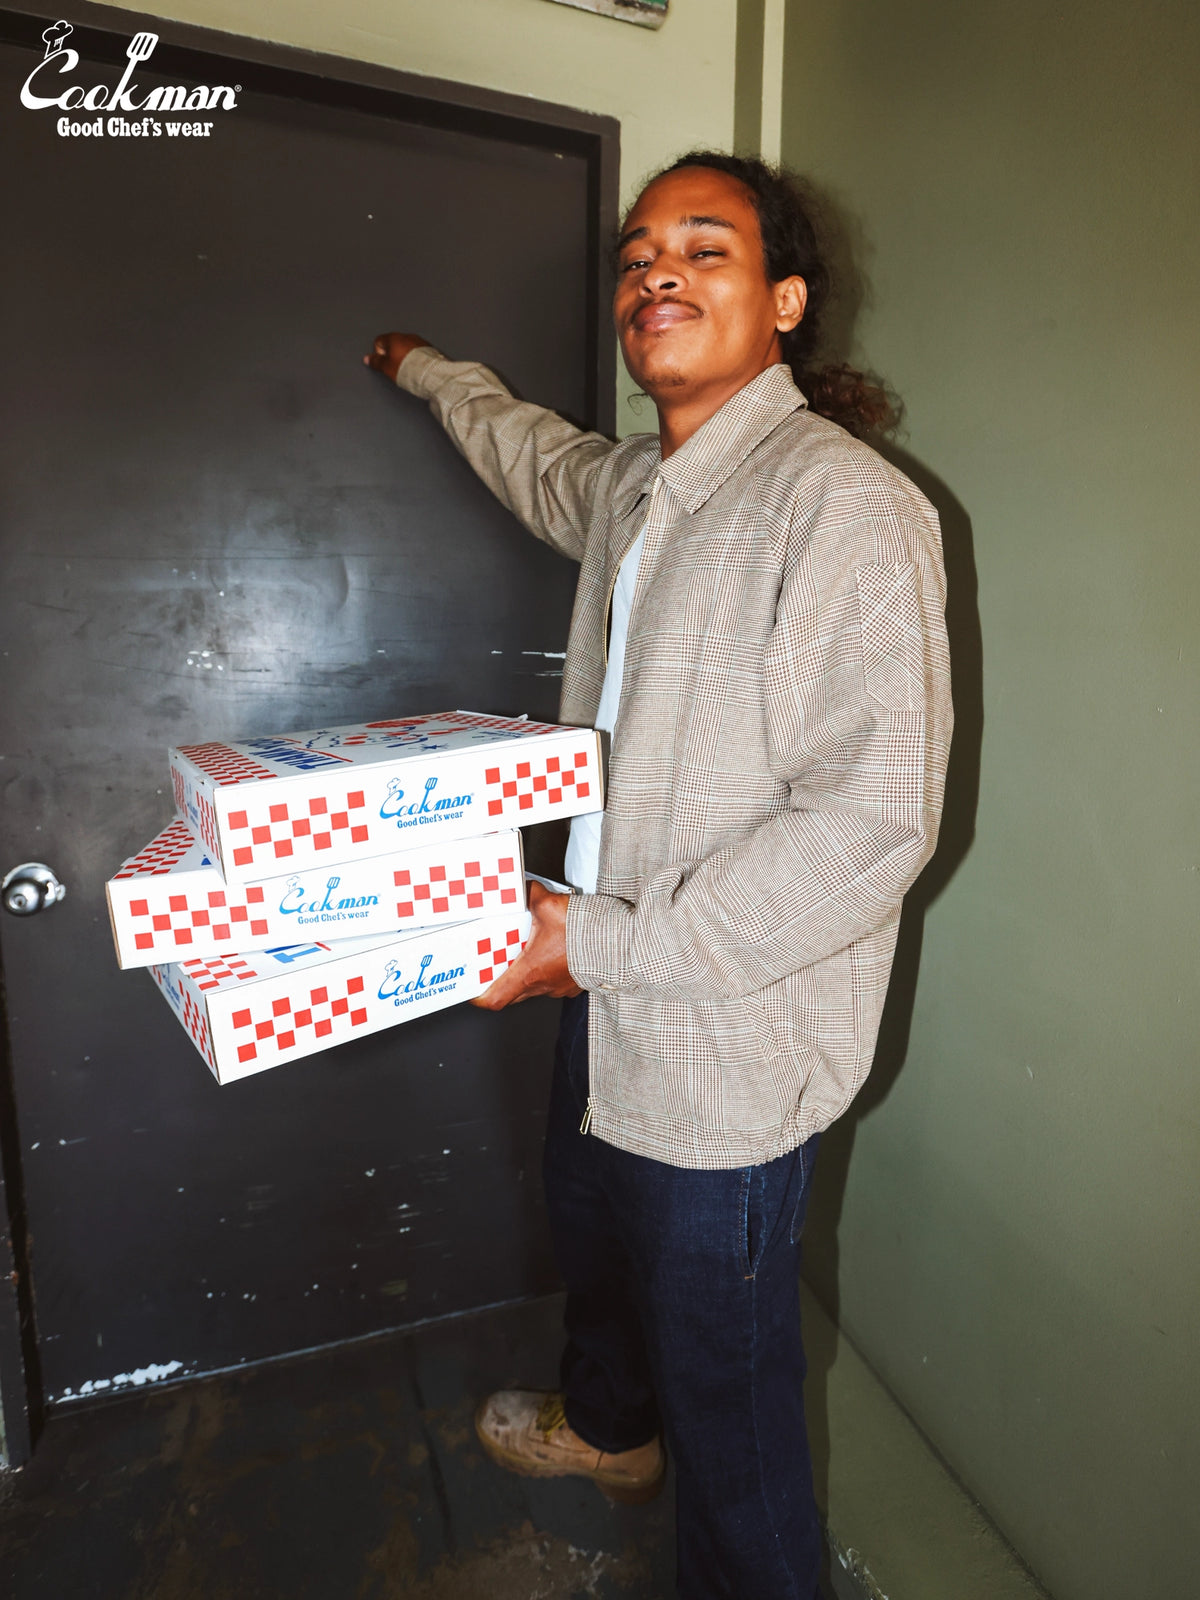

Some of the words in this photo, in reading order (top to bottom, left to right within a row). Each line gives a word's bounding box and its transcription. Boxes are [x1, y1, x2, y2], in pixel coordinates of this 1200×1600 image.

[379, 777, 473, 820] Cookman
[396, 815, 421, 829] Good
[419, 812, 445, 825] Chef's
[444, 810, 464, 821] wear
[279, 876, 380, 915] Cookman
[298, 914, 322, 925] Good
[320, 911, 348, 923] Chef's
[347, 910, 370, 920] wear
[377, 954, 465, 1001] Cookman
[394, 992, 416, 1007] Good
[414, 987, 439, 1001] Chef's
[437, 982, 457, 995] wear
